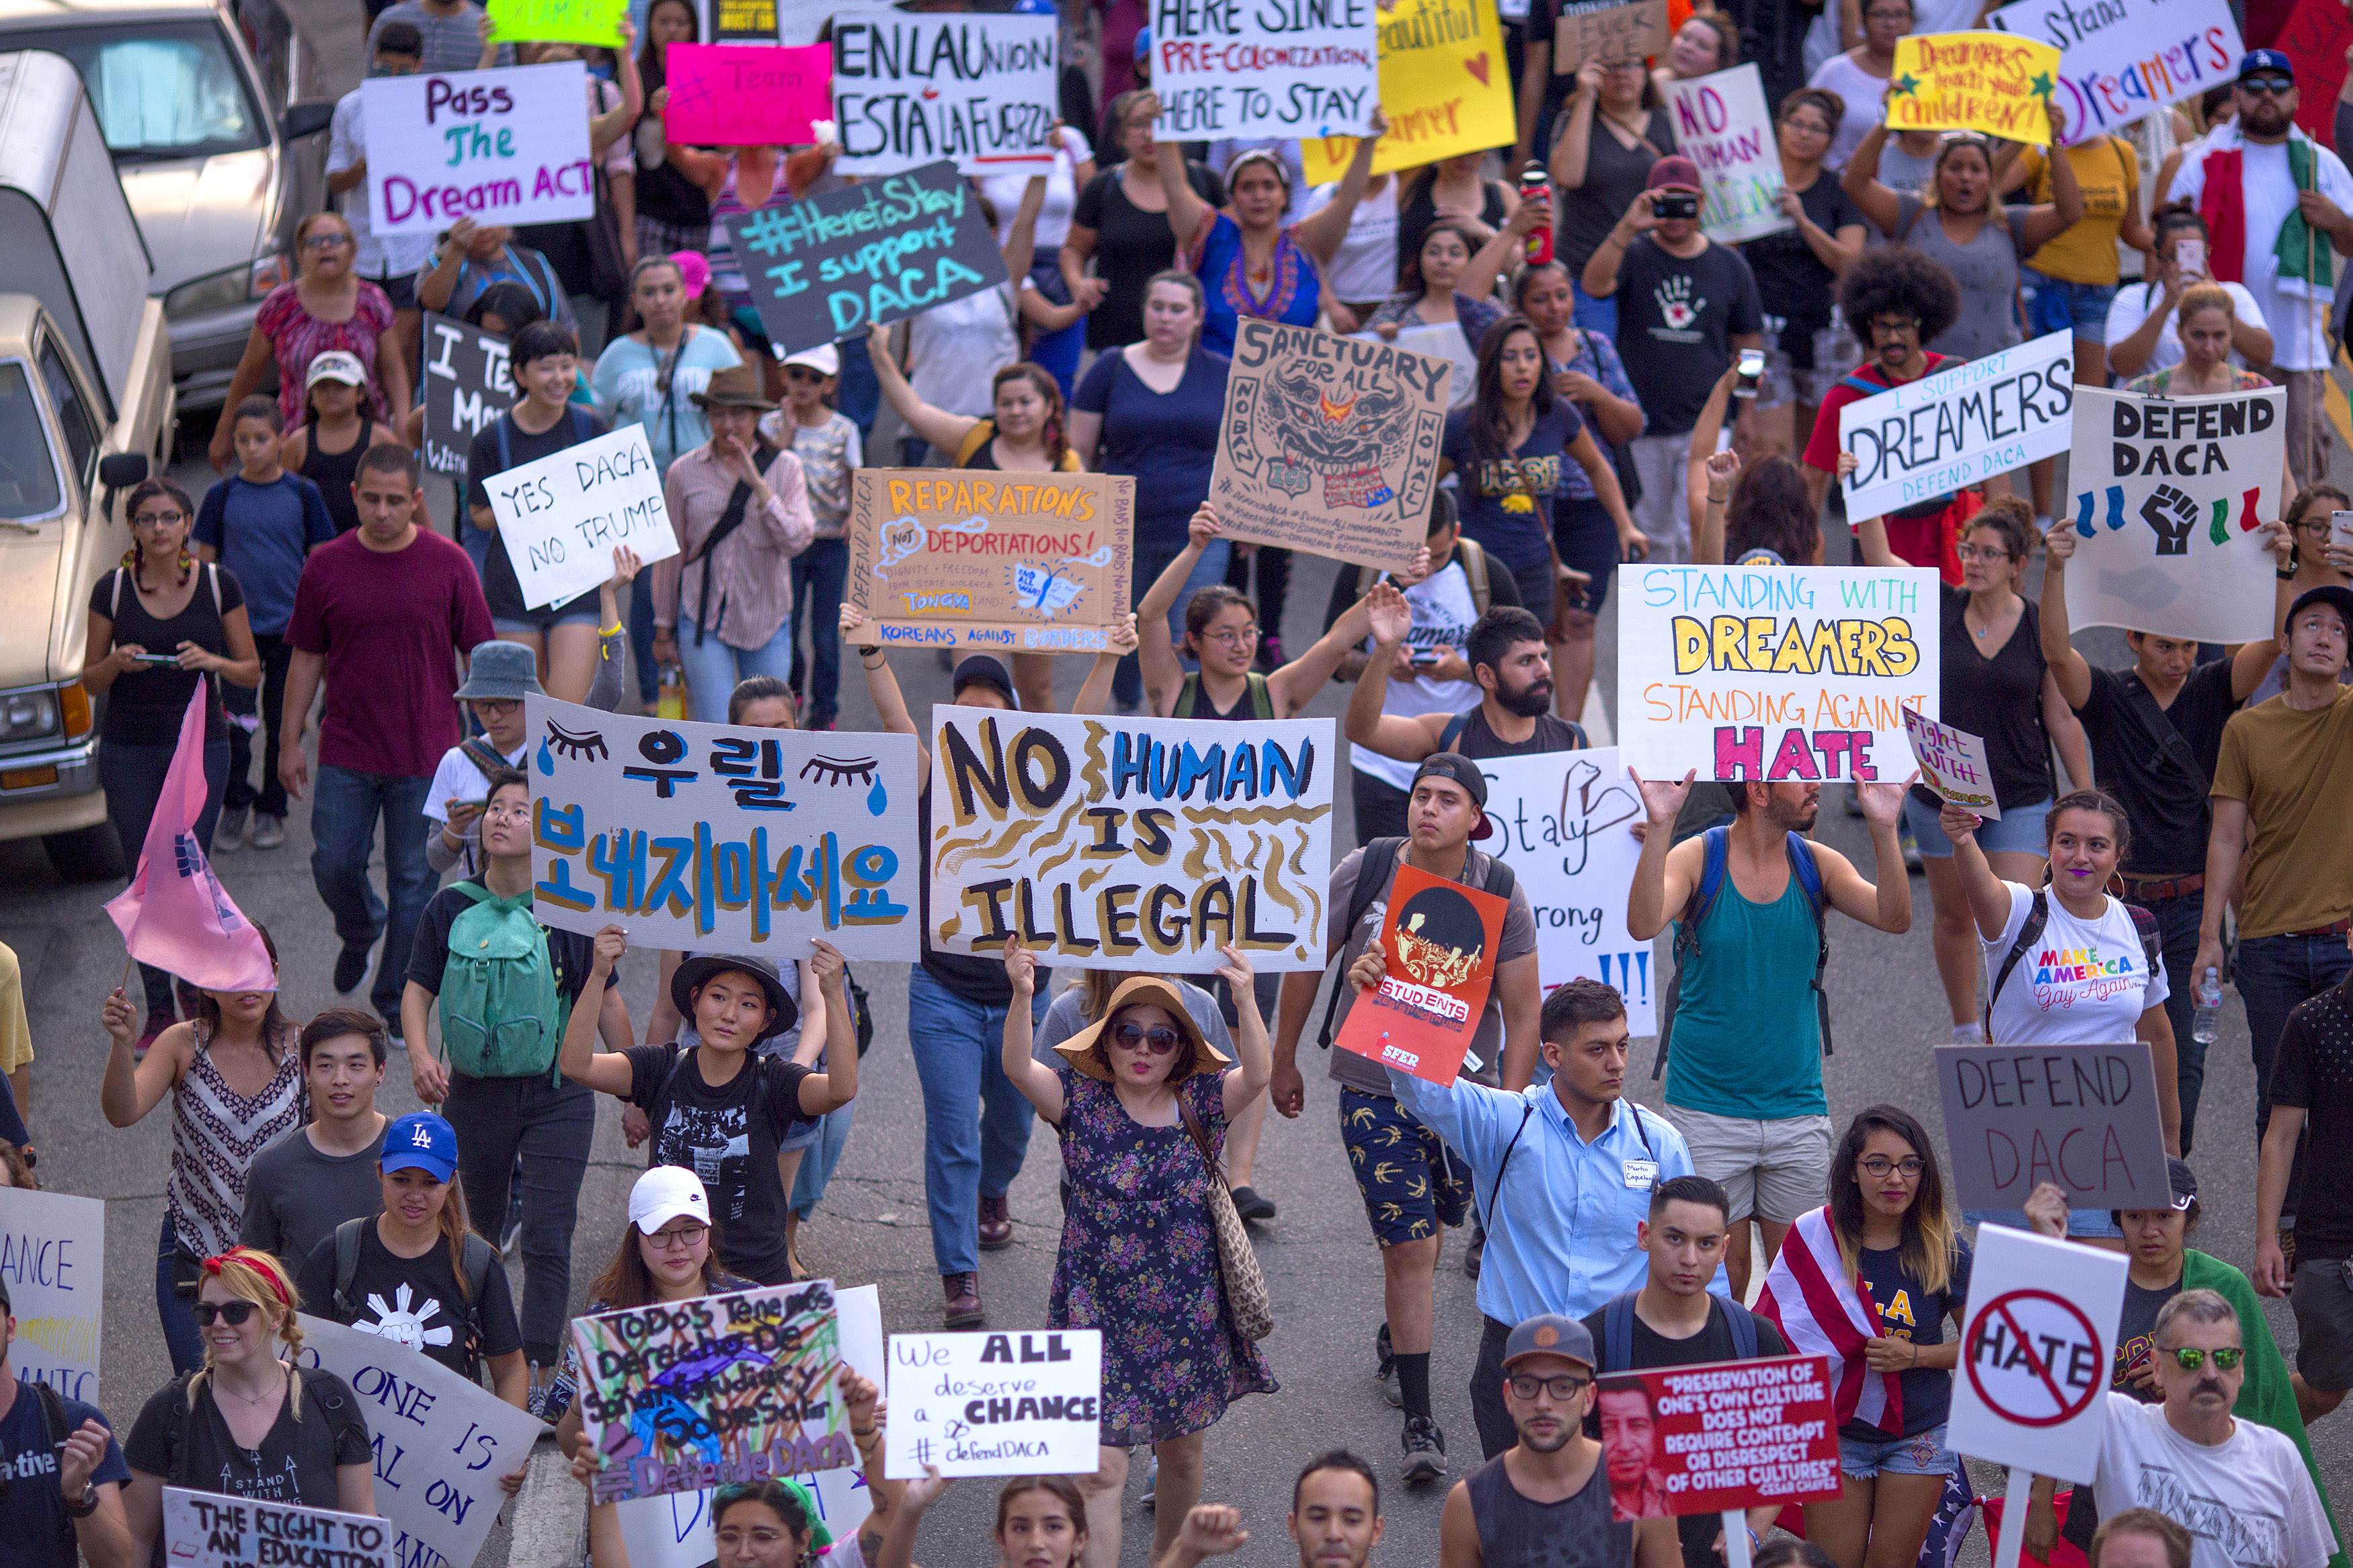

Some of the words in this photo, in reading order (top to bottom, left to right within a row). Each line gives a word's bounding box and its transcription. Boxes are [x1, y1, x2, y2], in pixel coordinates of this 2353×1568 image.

[1157, 0, 1242, 38] HERE
[1255, 0, 1366, 33] SINCE
[424, 77, 515, 126] Pass
[1159, 85, 1228, 132] HERE
[1232, 86, 1273, 126] TO
[1275, 81, 1369, 124] STAY
[443, 120, 518, 168] The
[382, 173, 522, 225] Dream
[764, 259, 811, 299] I
[817, 214, 957, 283] support
[826, 255, 986, 334] DACA
[428, 323, 465, 382] I
[1238, 323, 1449, 403] SANCTUARY
[1283, 358, 1337, 383] FOR
[1342, 366, 1395, 395] ALL
[1892, 390, 1905, 411] I
[1920, 352, 2012, 401] SUPPORT
[1849, 358, 2073, 491] DREAMERS
[2113, 398, 2275, 440] DEFEND
[501, 476, 554, 518] YES
[575, 442, 650, 492] DACA
[1902, 461, 1972, 503] DEFEND
[1983, 444, 2026, 474] DACA
[2113, 441, 2230, 477] DACA
[856, 474, 873, 526] DACA
[887, 479, 1099, 522] REPARATIONS
[528, 536, 566, 571] NO
[575, 495, 663, 549] TRUMP
[926, 530, 1096, 557] DEPORTATIONS!
[852, 531, 872, 610] DEFEND
[916, 579, 947, 589] STATE
[941, 563, 990, 577] FREEDOM
[1643, 569, 1817, 612] STANDING
[1840, 578, 1918, 614] WITH
[902, 591, 970, 612] TONGVA
[880, 624, 957, 646] KOREANS
[967, 629, 1017, 645] AGAINST
[1023, 628, 1110, 650] BORDERS
[1671, 615, 1921, 677] DREAMERS
[1643, 683, 1806, 725] STANDING
[1814, 689, 1928, 732] AGAINST
[1714, 725, 1879, 782] HATE
[1902, 706, 1973, 759] Fight
[937, 716, 1072, 828] NO
[1112, 729, 1315, 804] HUMAN
[1078, 807, 1178, 867] IS
[960, 874, 1299, 958] ILLEGAL
[2038, 947, 2100, 967] MAKE
[1373, 994, 1429, 1022] RESISTING
[1428, 1014, 1464, 1033] TRUMP
[1380, 980, 1467, 1020] STUDENTS
[2033, 985, 2077, 1012] Gay
[2079, 977, 2135, 1002] Again
[1380, 1056, 1395, 1064] Action
[1395, 1061, 1414, 1071] Network
[1382, 1044, 1420, 1067] SFER
[1956, 1055, 2132, 1110] DEFEND
[411, 1123, 432, 1150] LA
[1985, 1124, 2136, 1192] DACA
[896, 1339, 952, 1368] We
[979, 1333, 1072, 1364] ALL
[1790, 1362, 1814, 1383] OF
[1974, 1319, 2098, 1391] HATE
[934, 1372, 1037, 1397] deserve
[1709, 1388, 1751, 1410] OWN
[1751, 1381, 1825, 1406] CULTURE
[352, 1365, 437, 1428] ONE
[452, 1422, 498, 1471] IS
[914, 1408, 930, 1423] a
[964, 1395, 1099, 1425] CHANCE
[1701, 1411, 1748, 1432] DOES
[1748, 1405, 1784, 1426] NOT
[1663, 1429, 1736, 1456] REQUIRE
[1736, 1419, 1827, 1447] CONTEMPT
[1685, 1452, 1712, 1472] OR
[1712, 1442, 1810, 1469] DISRESPECT
[235, 1475, 284, 1490] STAND
[424, 1478, 475, 1526] ON
[1665, 1473, 1690, 1494] OF
[1690, 1468, 1747, 1492] OTHER
[1796, 1477, 1839, 1493] CHAVEZ
[189, 1500, 247, 1534] THE
[255, 1507, 337, 1545] RIGHT
[343, 1522, 383, 1553] TO
[206, 1530, 241, 1557] AN
